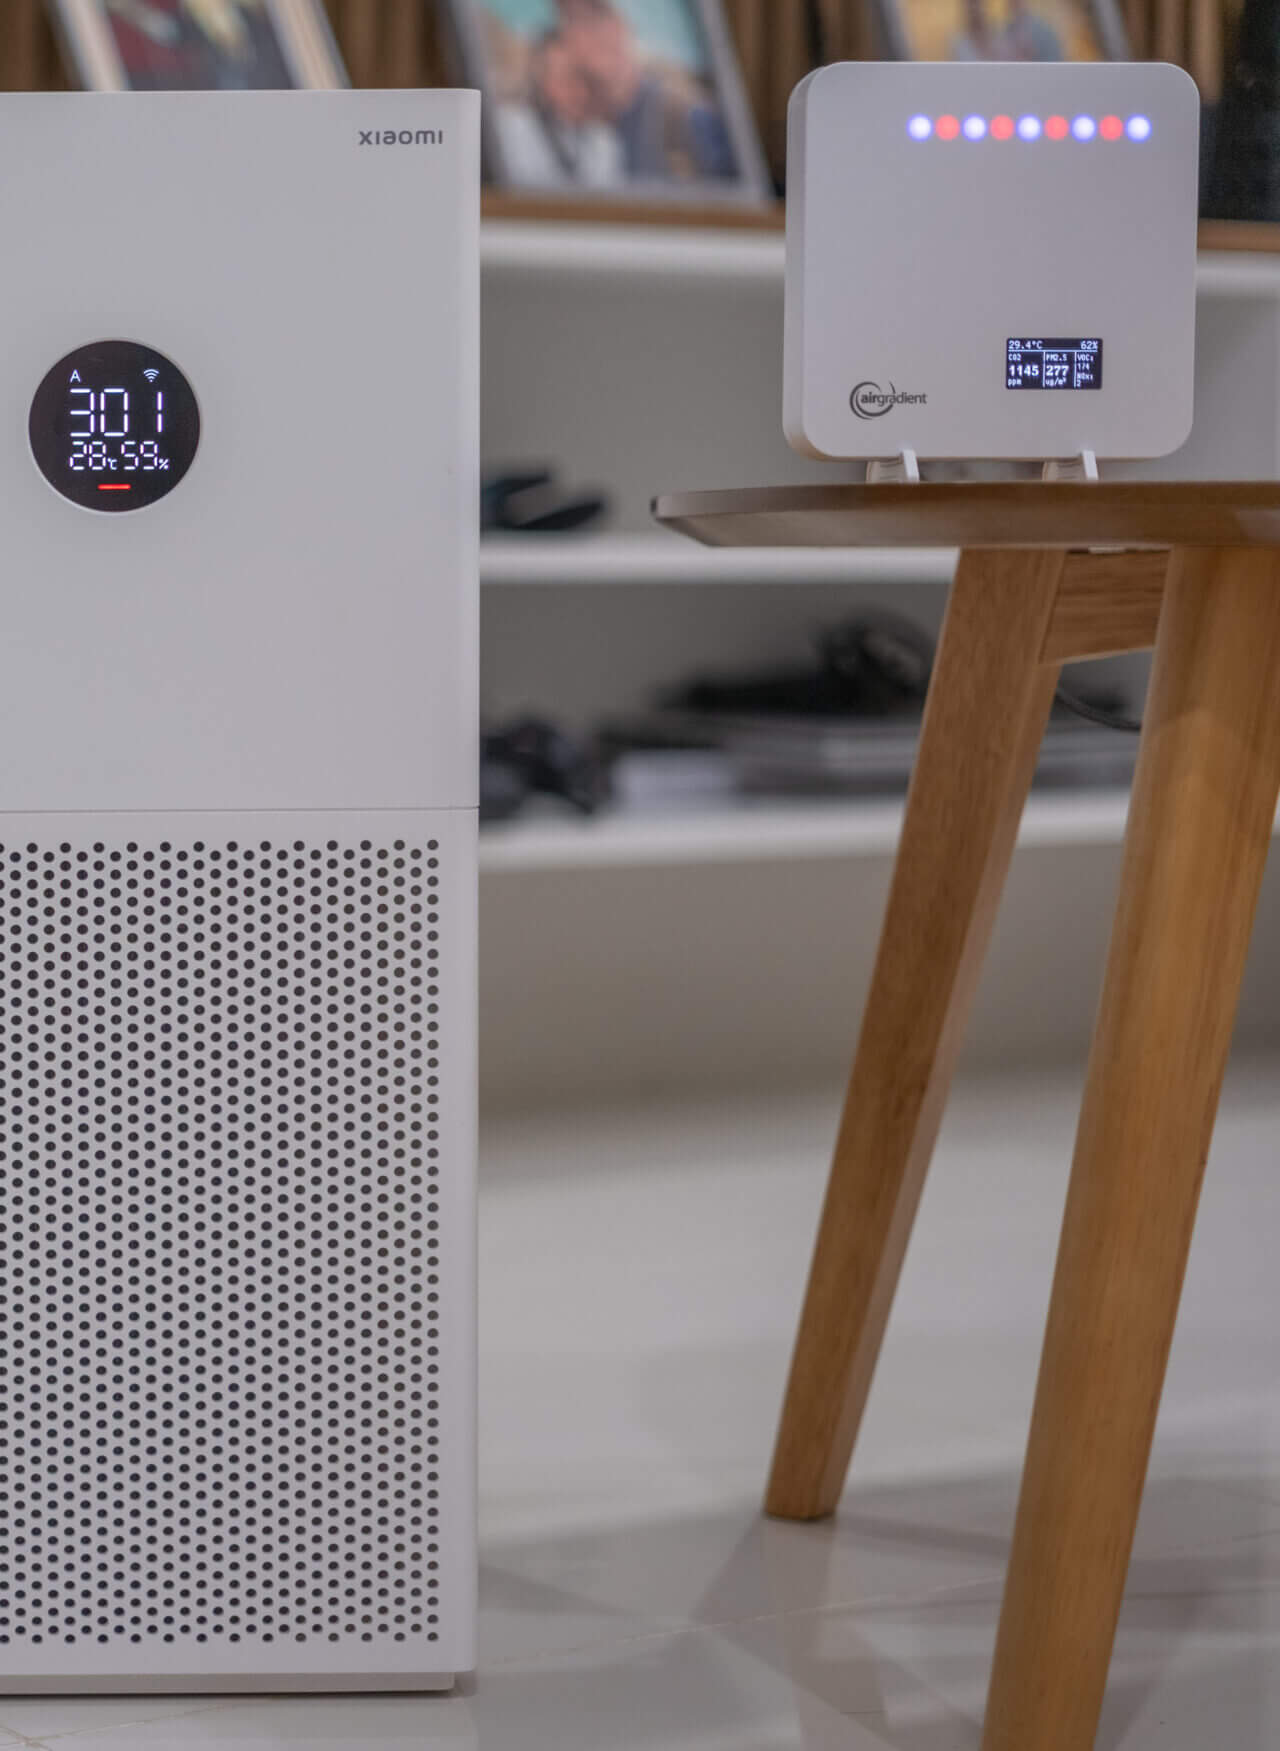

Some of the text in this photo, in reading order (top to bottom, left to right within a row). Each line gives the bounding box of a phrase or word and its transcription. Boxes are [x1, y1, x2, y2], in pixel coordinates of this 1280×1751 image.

[1080, 341, 1098, 350] 62%
[70, 369, 81, 383] A
[1009, 365, 1039, 376] 1145
[1046, 365, 1069, 376] 277
[861, 392, 927, 407] airgradient
[70, 388, 163, 437] 301
